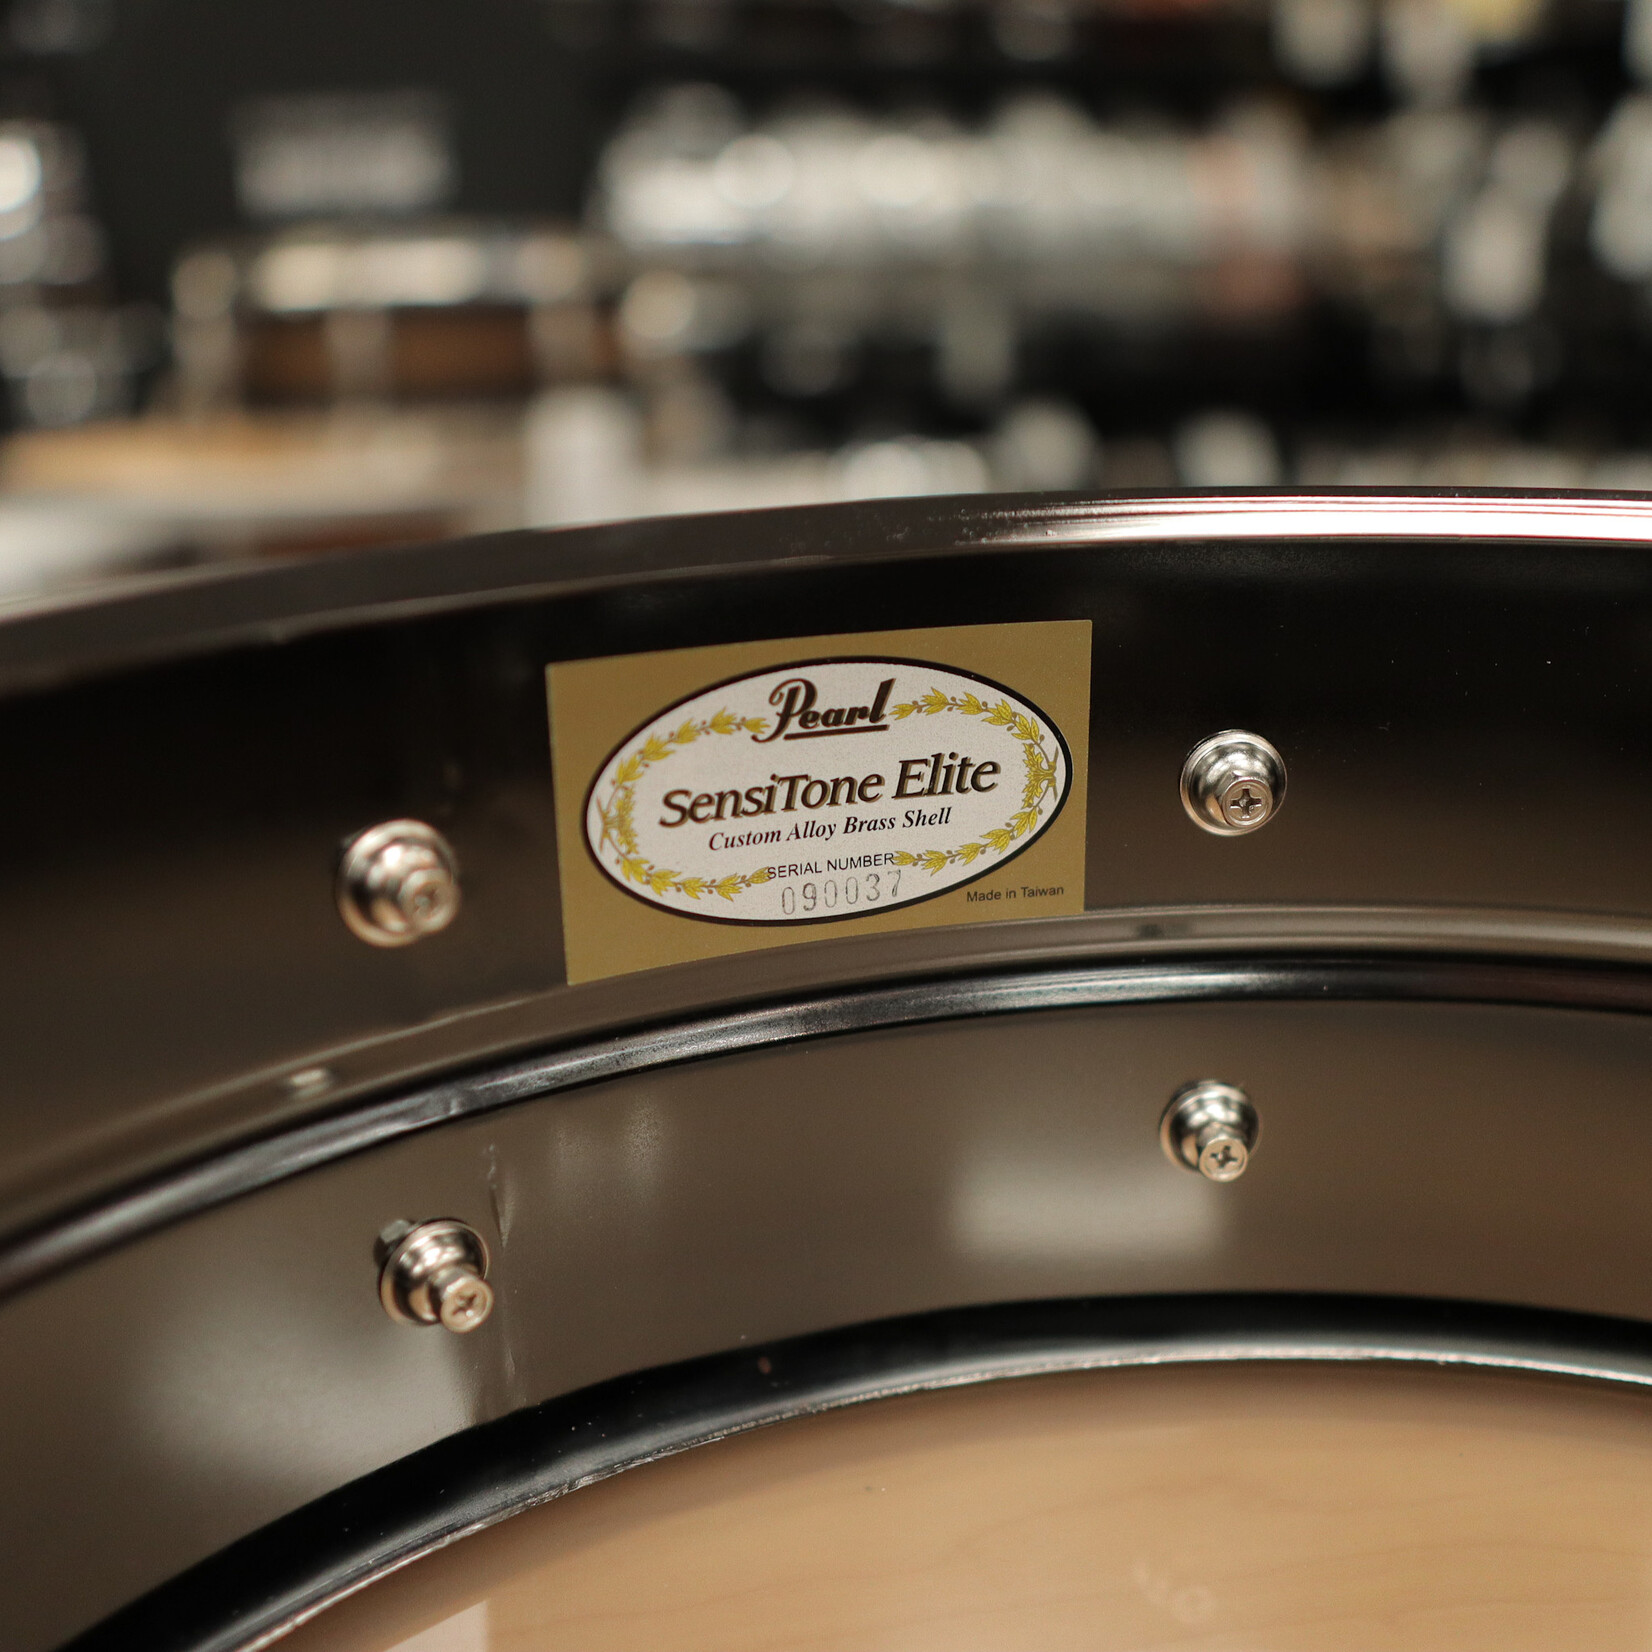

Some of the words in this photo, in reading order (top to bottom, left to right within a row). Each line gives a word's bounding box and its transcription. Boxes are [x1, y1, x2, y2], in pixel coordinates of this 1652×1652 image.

[752, 677, 896, 742] Pearl
[659, 773, 885, 829] SensiTone
[893, 751, 1001, 799] Elite
[708, 829, 782, 851] Custom
[786, 819, 838, 843] Alloy
[843, 815, 896, 835] Brass
[902, 807, 953, 827] Shell
[767, 862, 823, 879] SERIAL
[826, 853, 895, 872] NUMBER
[781, 870, 902, 915] 090037
[966, 889, 1002, 902] Made
[1005, 888, 1017, 899] in
[1020, 885, 1064, 898] Taiwan
